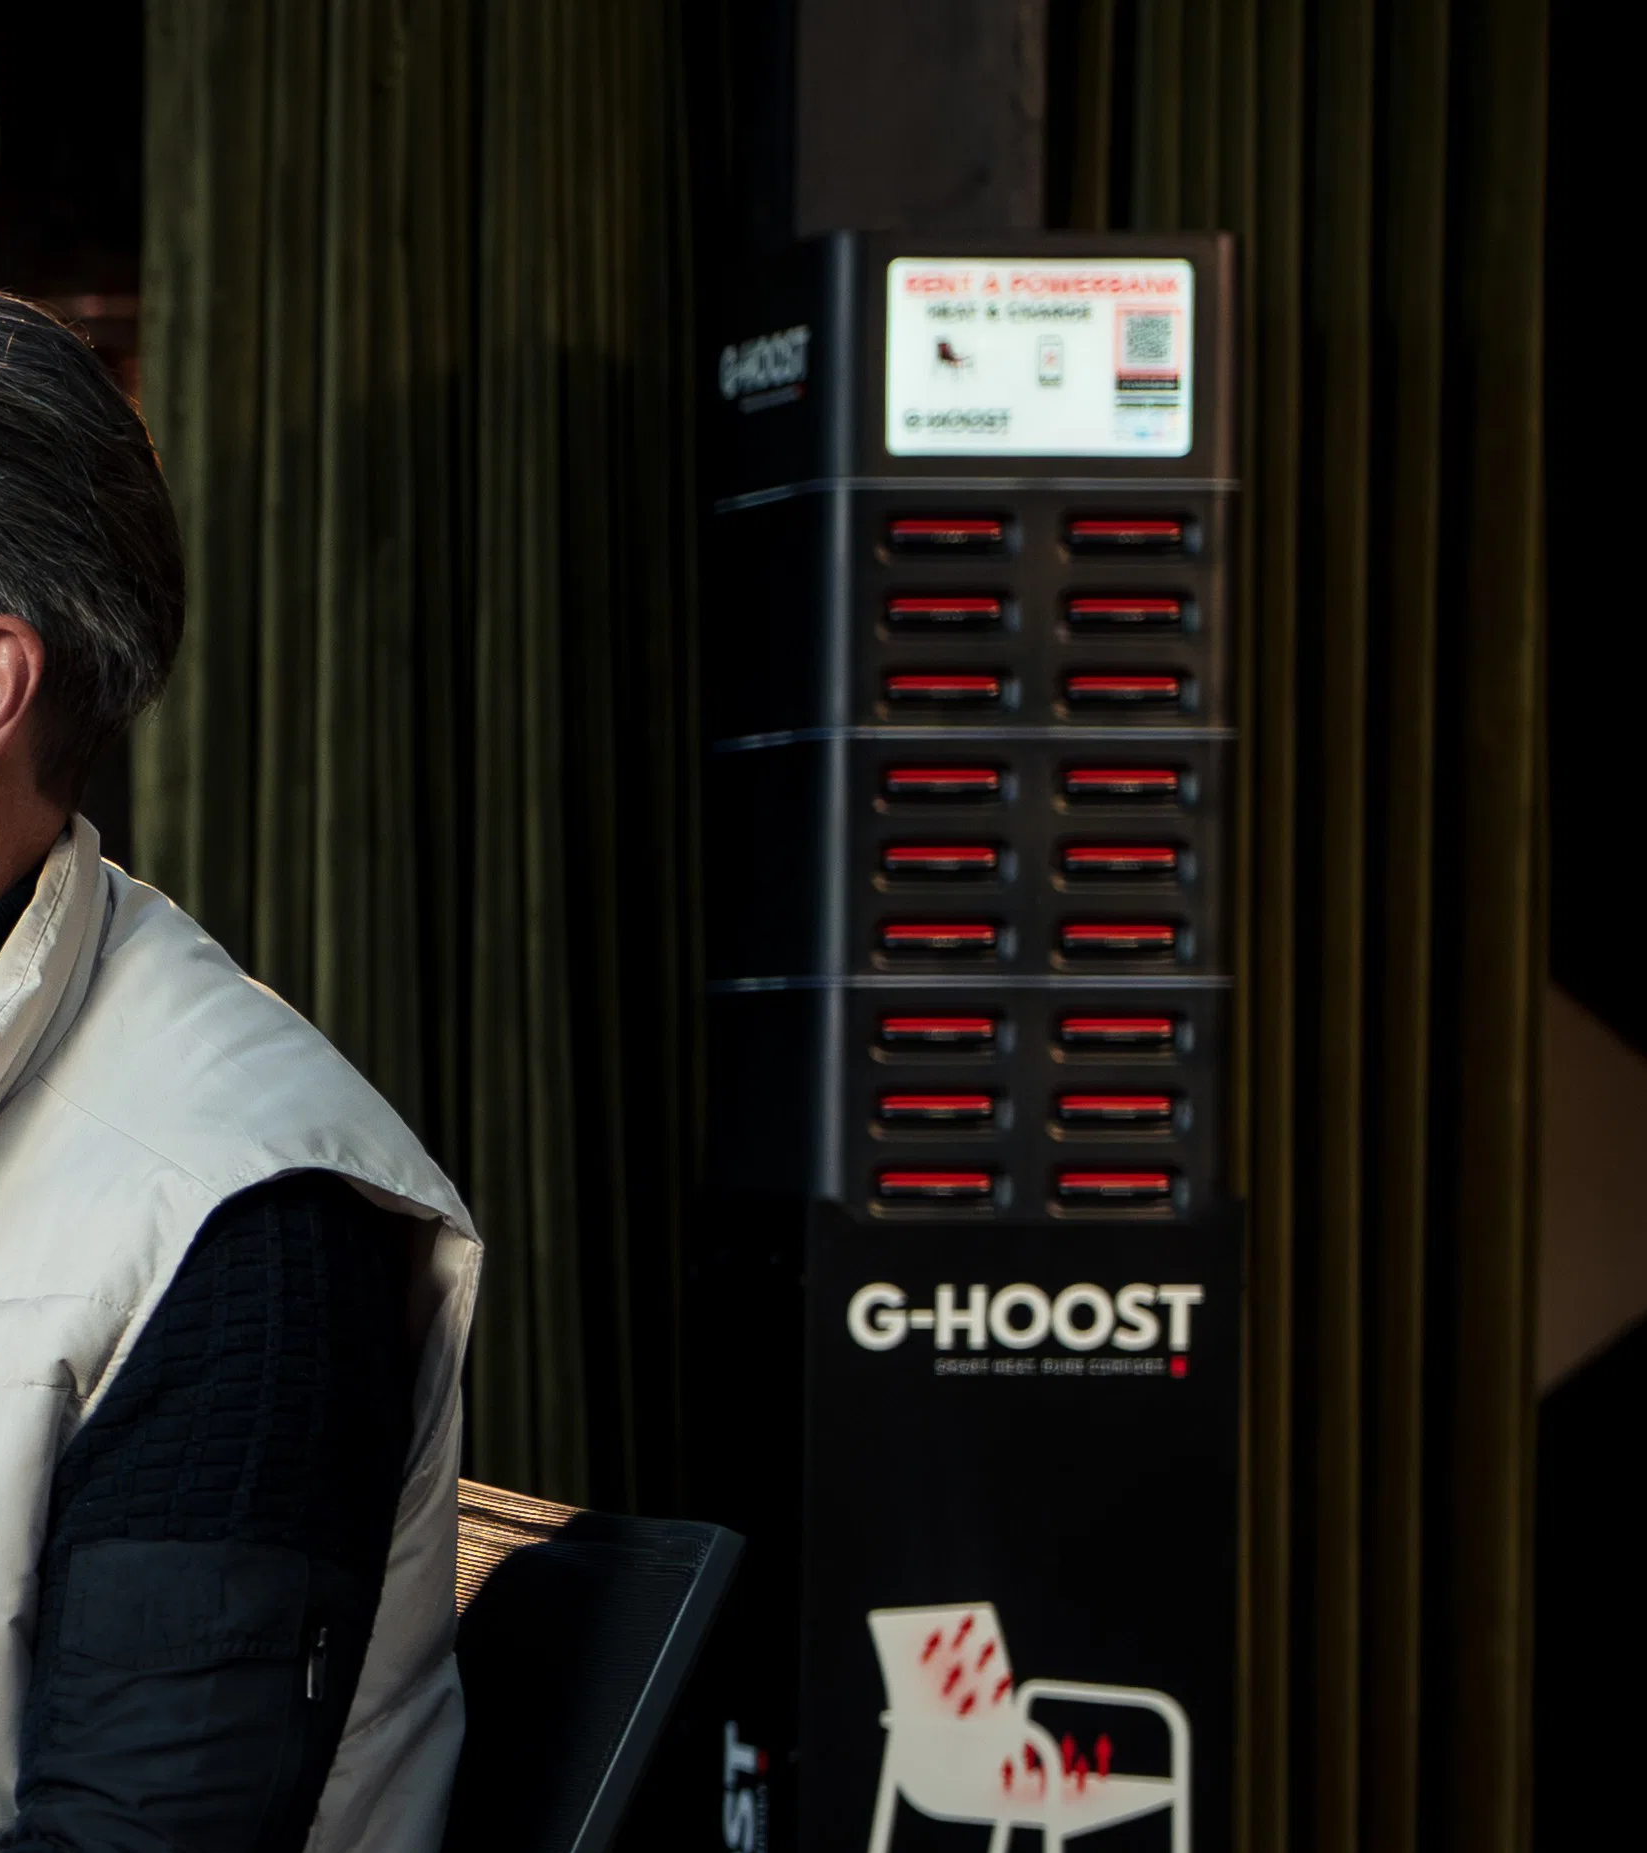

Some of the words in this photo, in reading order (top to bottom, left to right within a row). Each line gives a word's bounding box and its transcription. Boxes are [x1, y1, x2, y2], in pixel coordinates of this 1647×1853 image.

[906, 275, 972, 293] RENT
[984, 275, 1001, 293] A
[1010, 275, 1178, 293] POWERBANK
[847, 1282, 1204, 1351] G-HOOST
